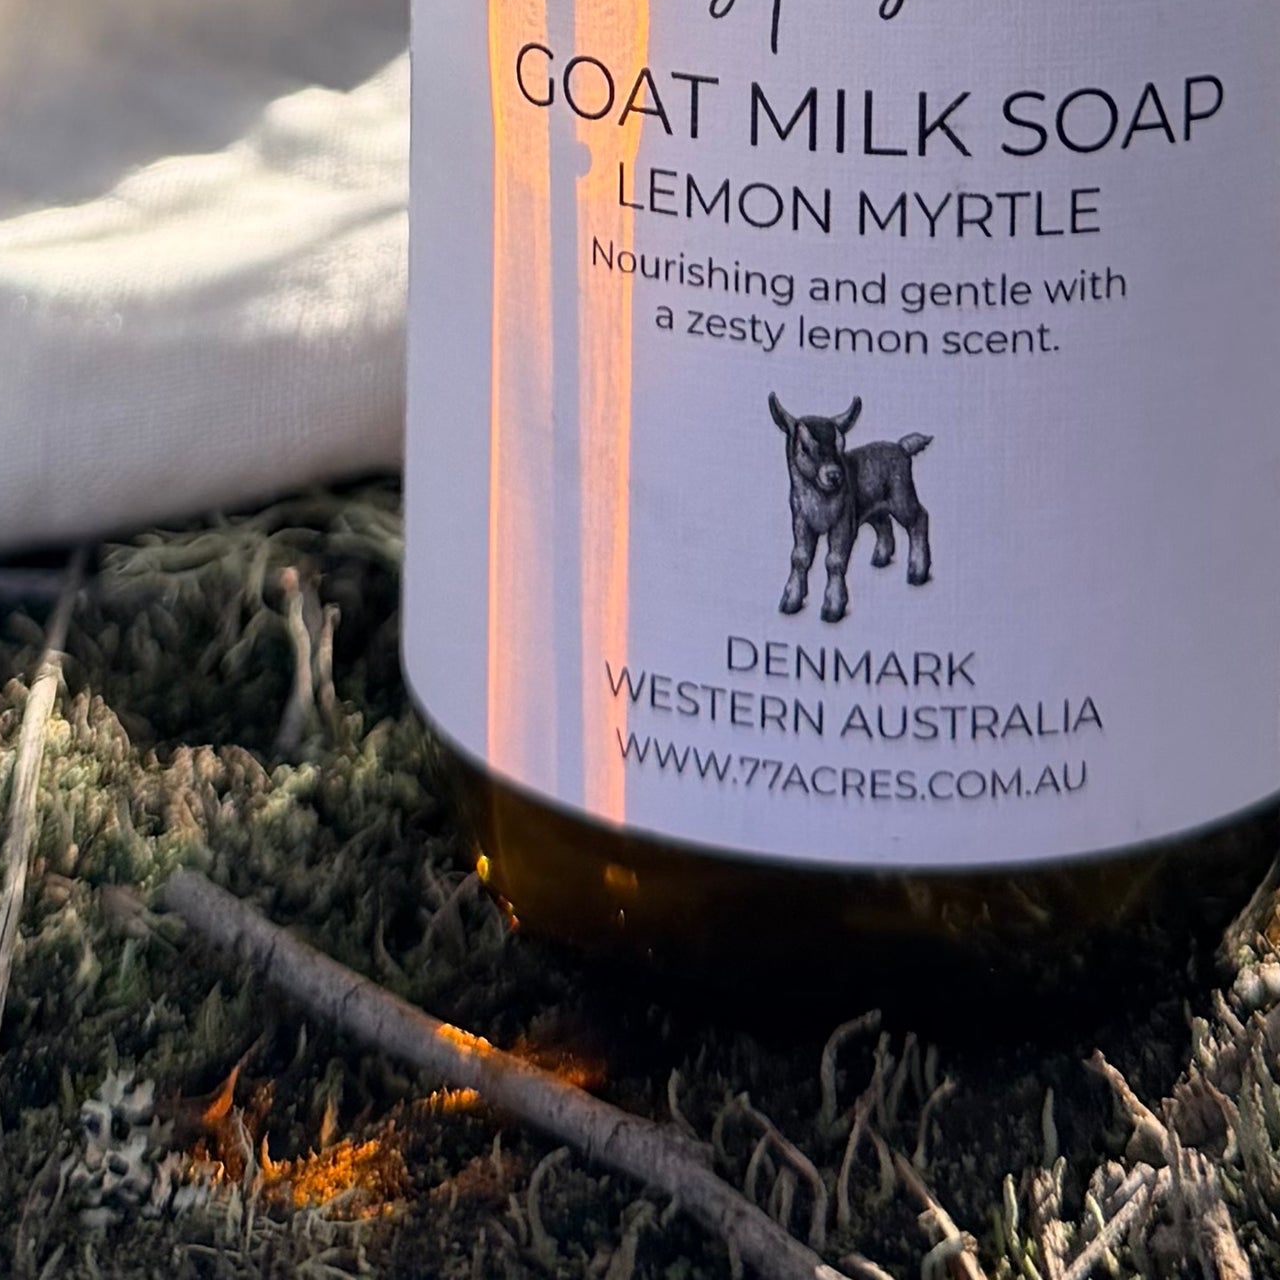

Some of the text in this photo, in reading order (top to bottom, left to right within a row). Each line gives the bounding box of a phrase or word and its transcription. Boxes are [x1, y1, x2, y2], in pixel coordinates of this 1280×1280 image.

[516, 42, 1224, 157] GOAT MILK SOAP
[619, 161, 1100, 238] LEMON MYRTLE
[593, 235, 1126, 314] Nourishing and gentle with
[655, 305, 1061, 355] a zesty lemon scent.
[727, 636, 975, 689] DENMARK
[605, 661, 1103, 743] WESTERN AUSTRALIA
[616, 727, 1086, 801] WWW.77ACRES.COM.AU
